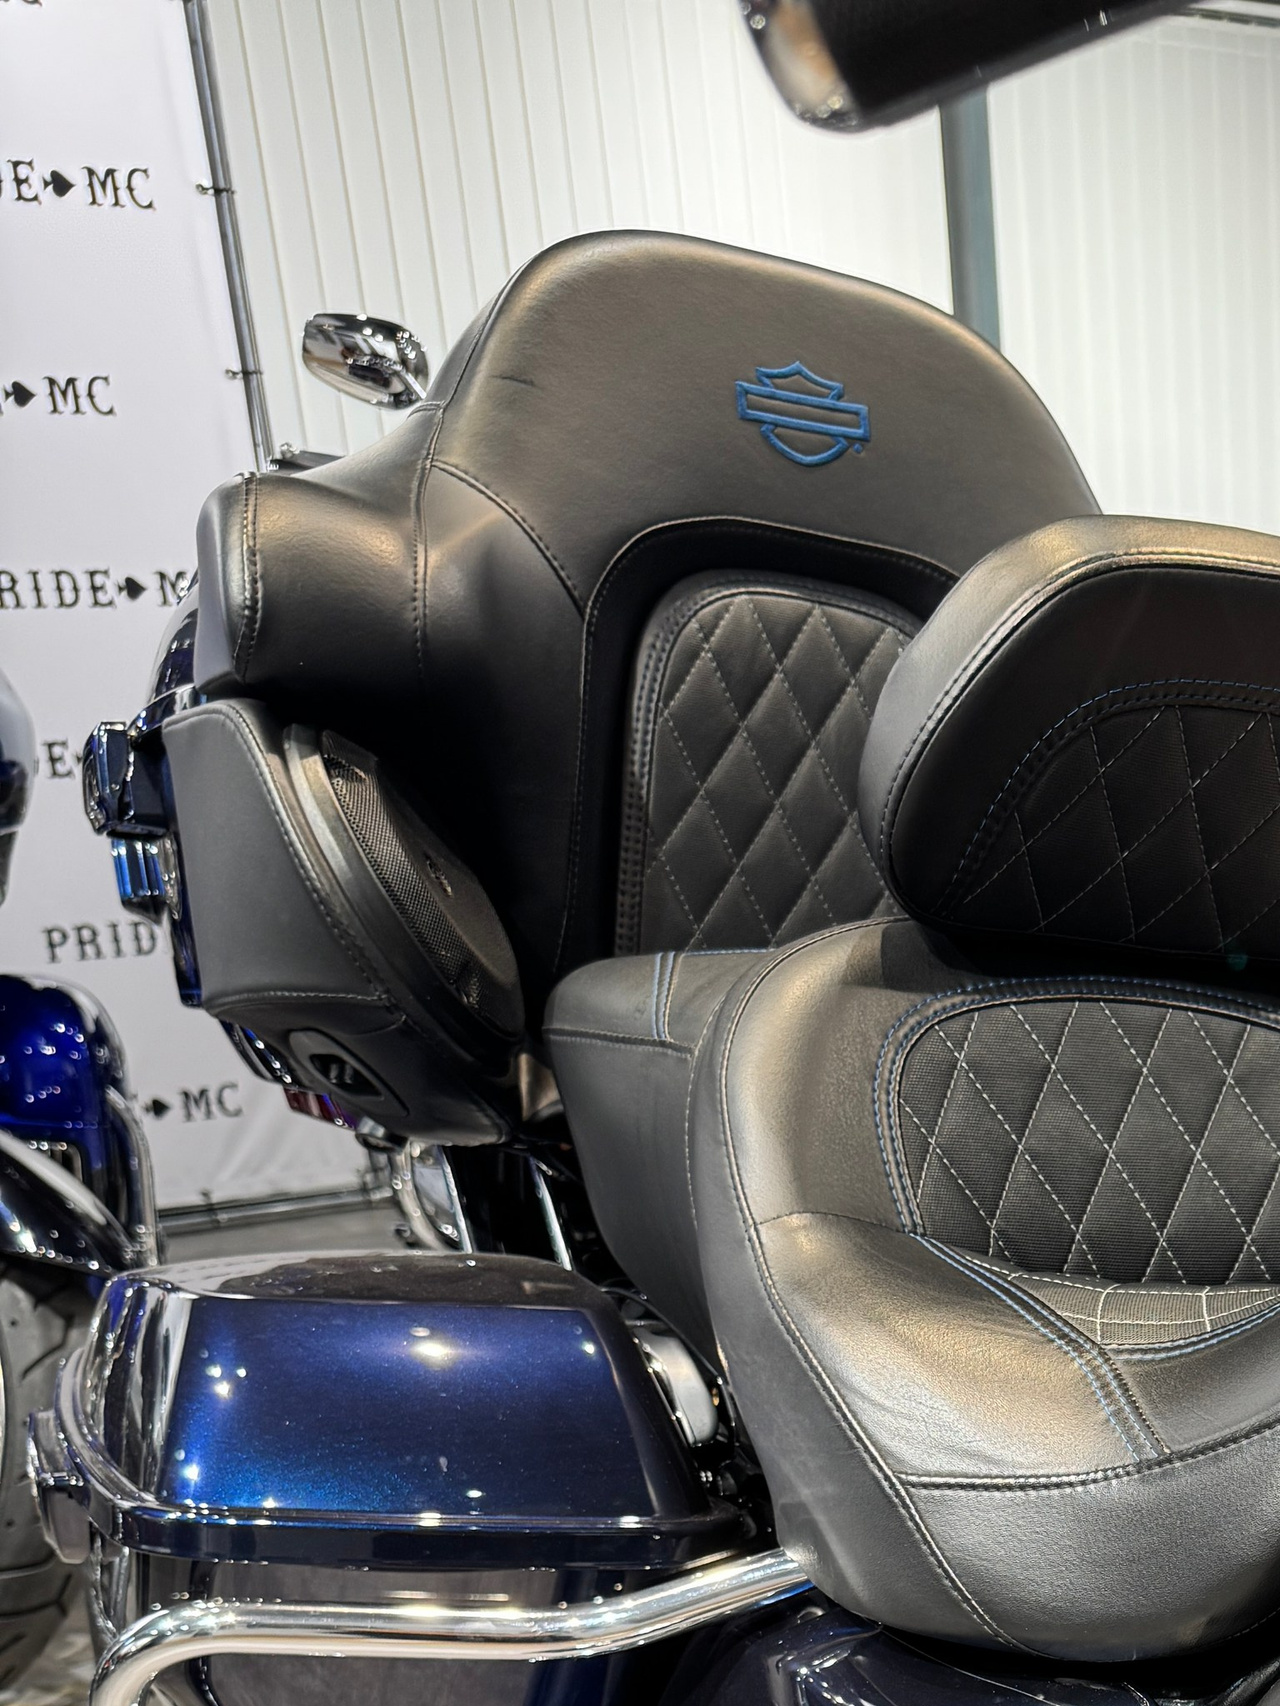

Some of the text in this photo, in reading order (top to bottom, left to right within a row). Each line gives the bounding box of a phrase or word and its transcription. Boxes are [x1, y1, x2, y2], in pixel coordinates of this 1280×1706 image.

[81, 165, 157, 212] MC
[42, 375, 117, 416] MC
[43, 920, 159, 964] PRID
[178, 1081, 243, 1123] MC
